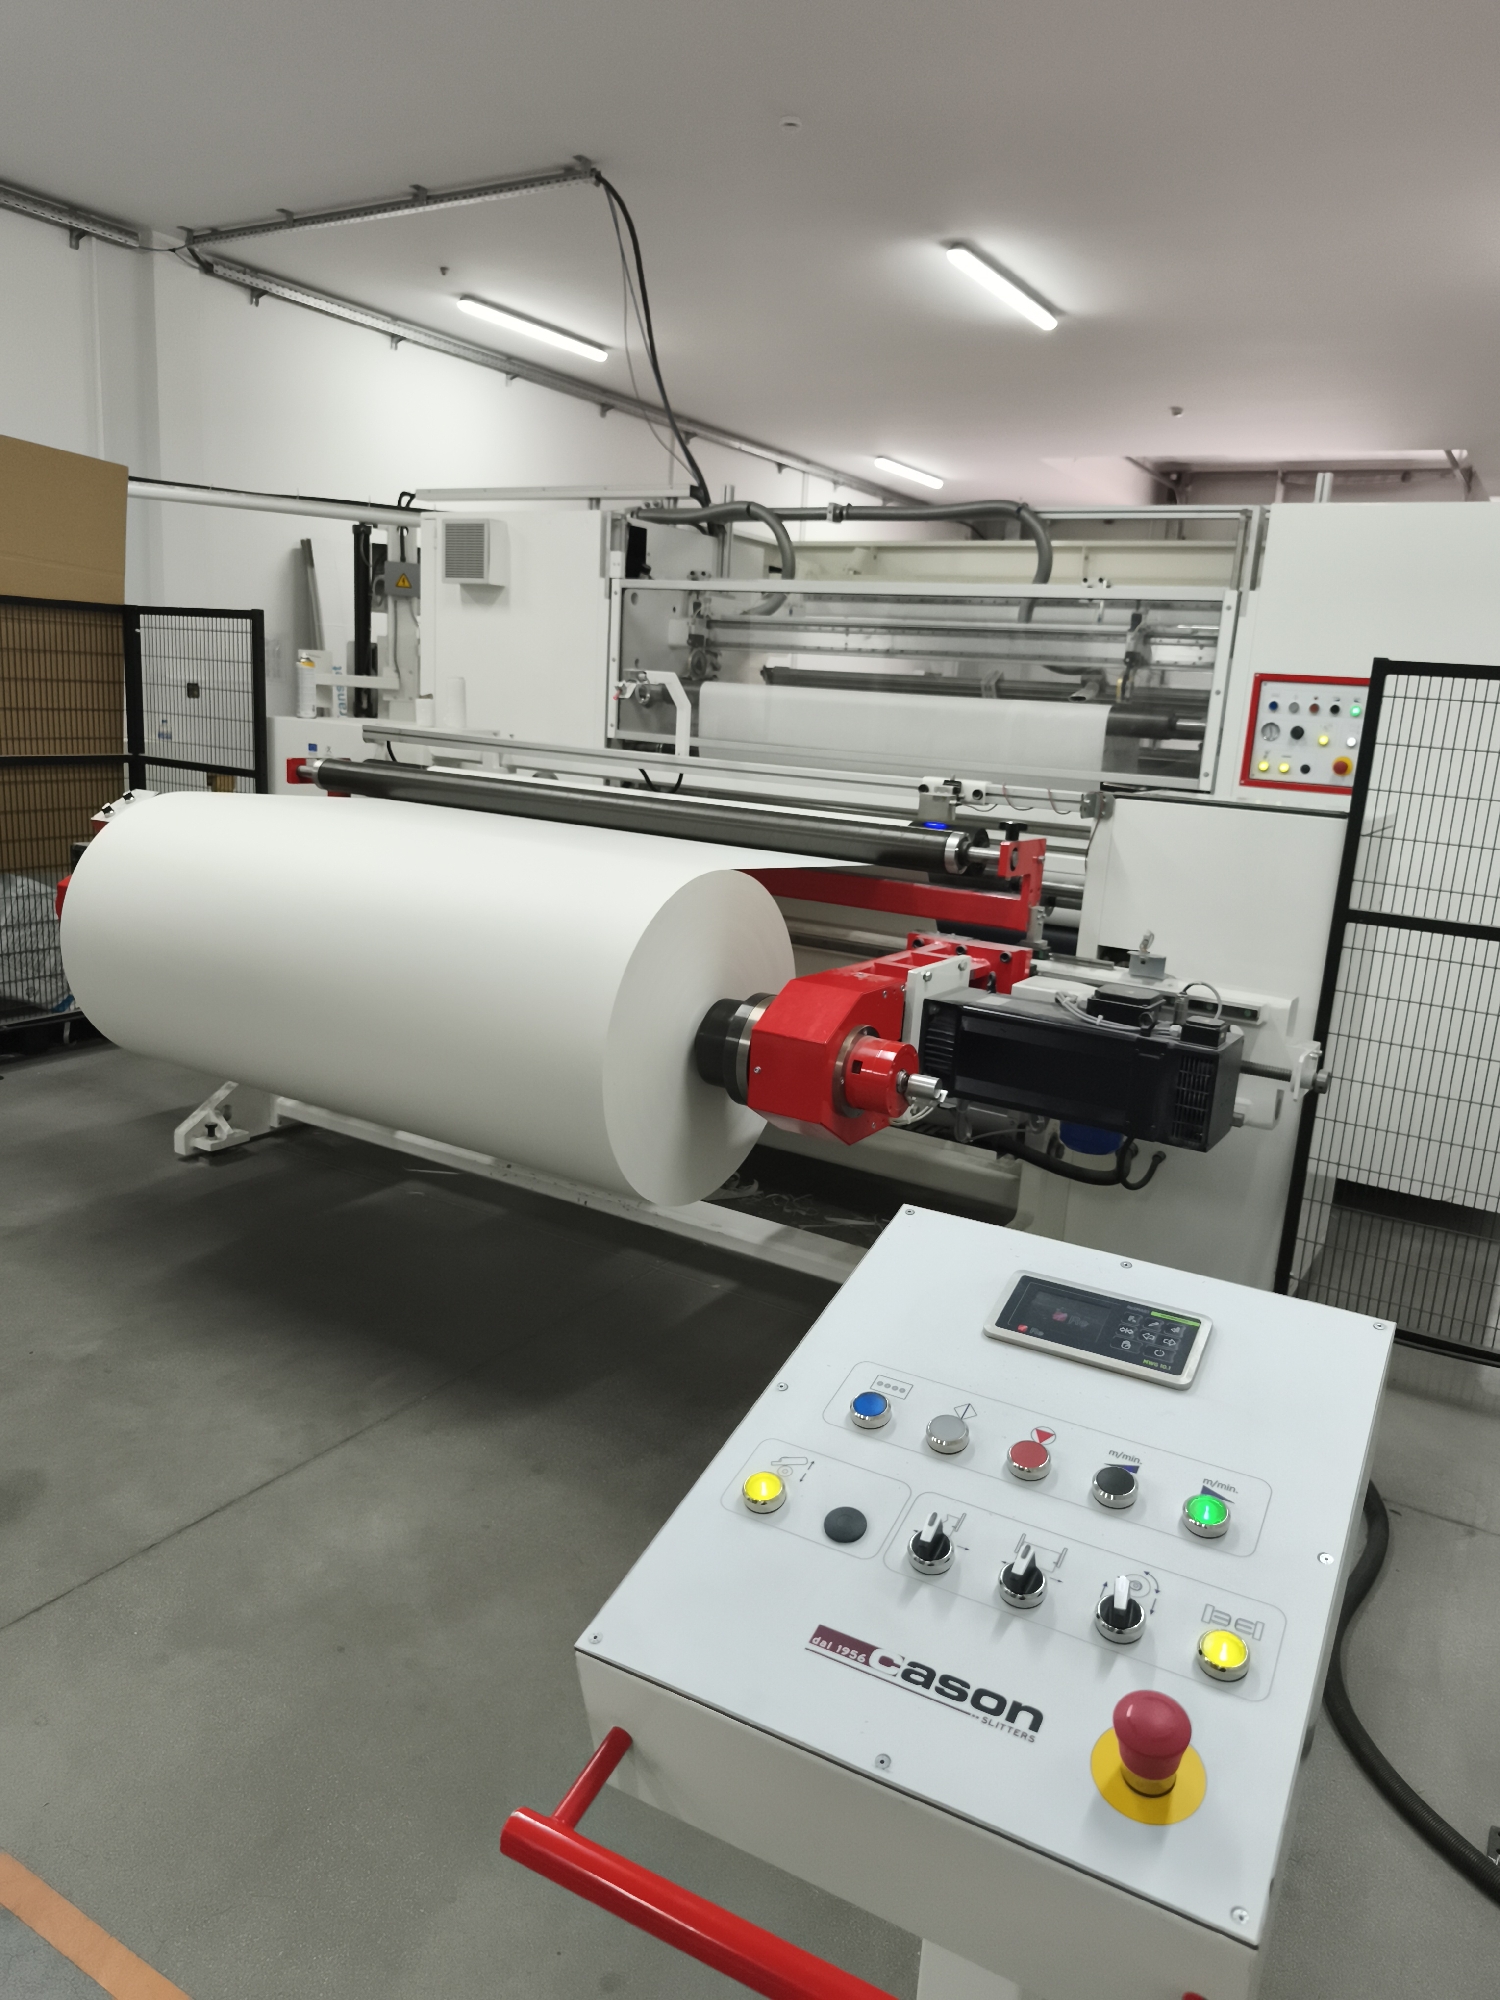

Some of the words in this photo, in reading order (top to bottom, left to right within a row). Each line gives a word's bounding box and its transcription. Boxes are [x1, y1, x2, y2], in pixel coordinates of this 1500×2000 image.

[1108, 1449, 1142, 1464] m/min.
[1203, 1478, 1238, 1493] m/min.
[836, 1644, 866, 1663] 1956
[868, 1648, 1044, 1733] Cason
[981, 1716, 1035, 1743] SLITTERS
